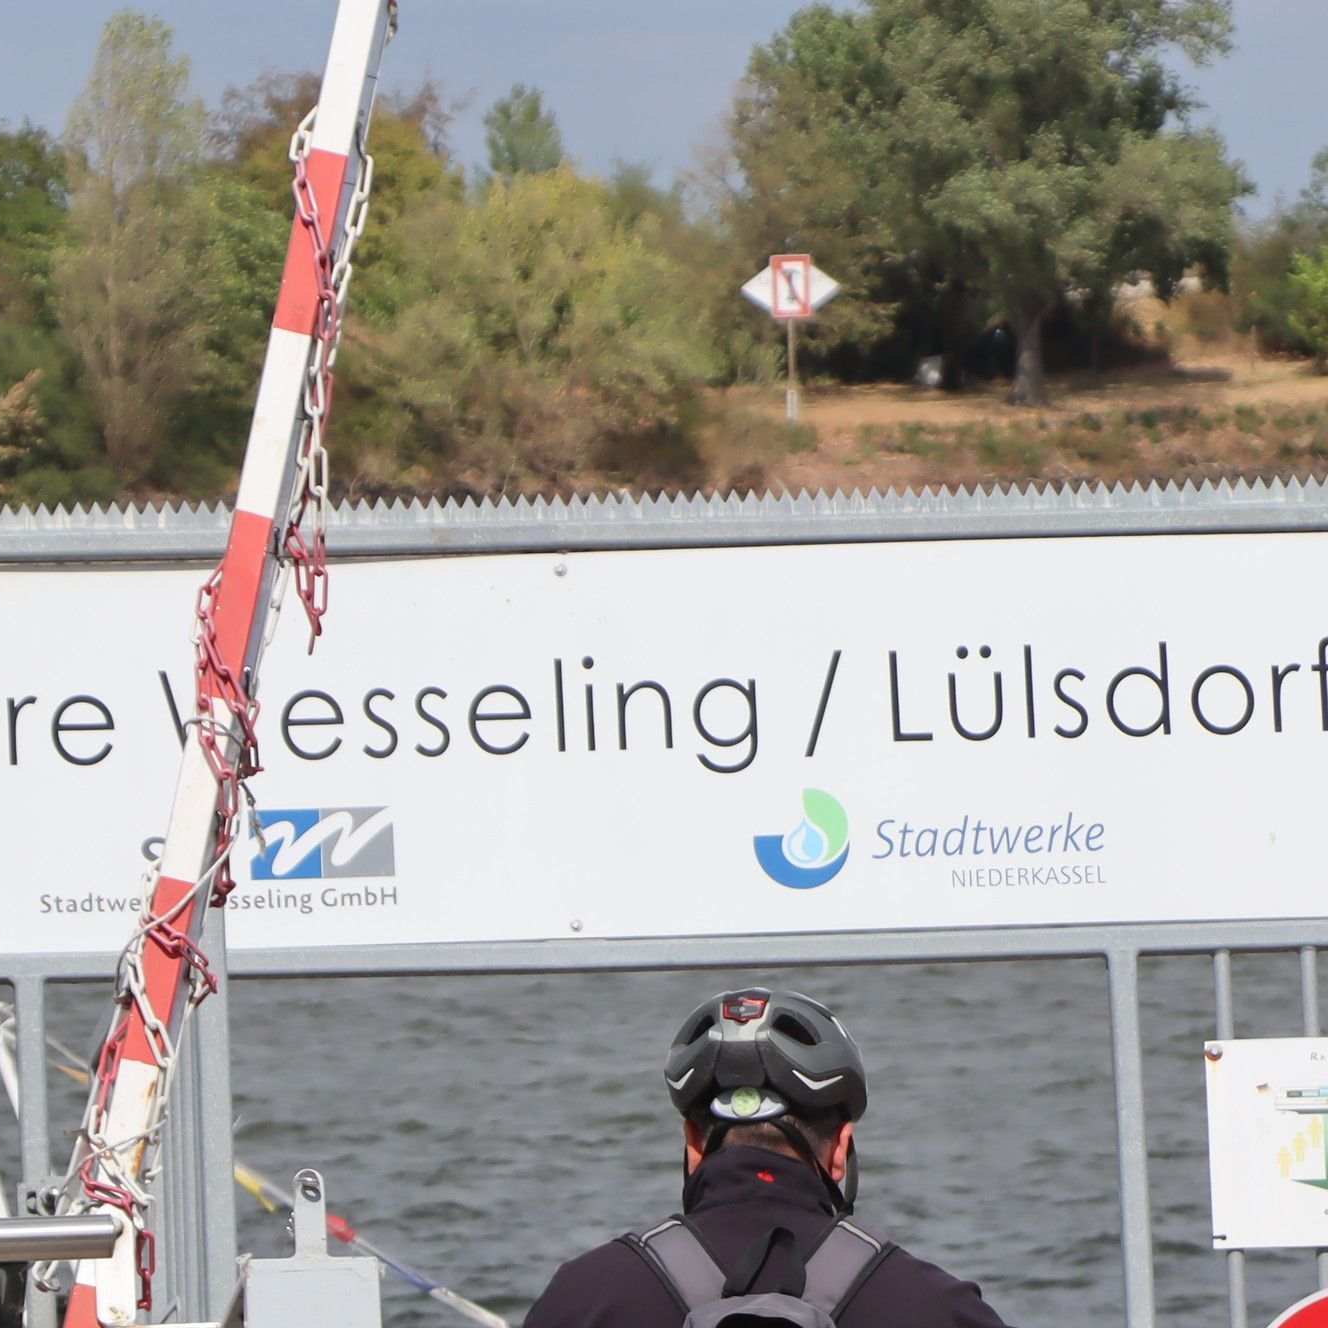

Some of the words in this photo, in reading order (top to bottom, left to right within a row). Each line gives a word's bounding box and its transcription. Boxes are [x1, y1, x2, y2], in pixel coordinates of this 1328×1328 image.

[158, 654, 759, 774] esseling
[804, 650, 843, 758] /
[871, 812, 1105, 859] Stadtwerke
[951, 865, 1107, 889] NIEDERKASSEL
[40, 893, 142, 913] Stadtwe
[228, 887, 313, 912] sseling
[322, 886, 398, 907] GmbH
